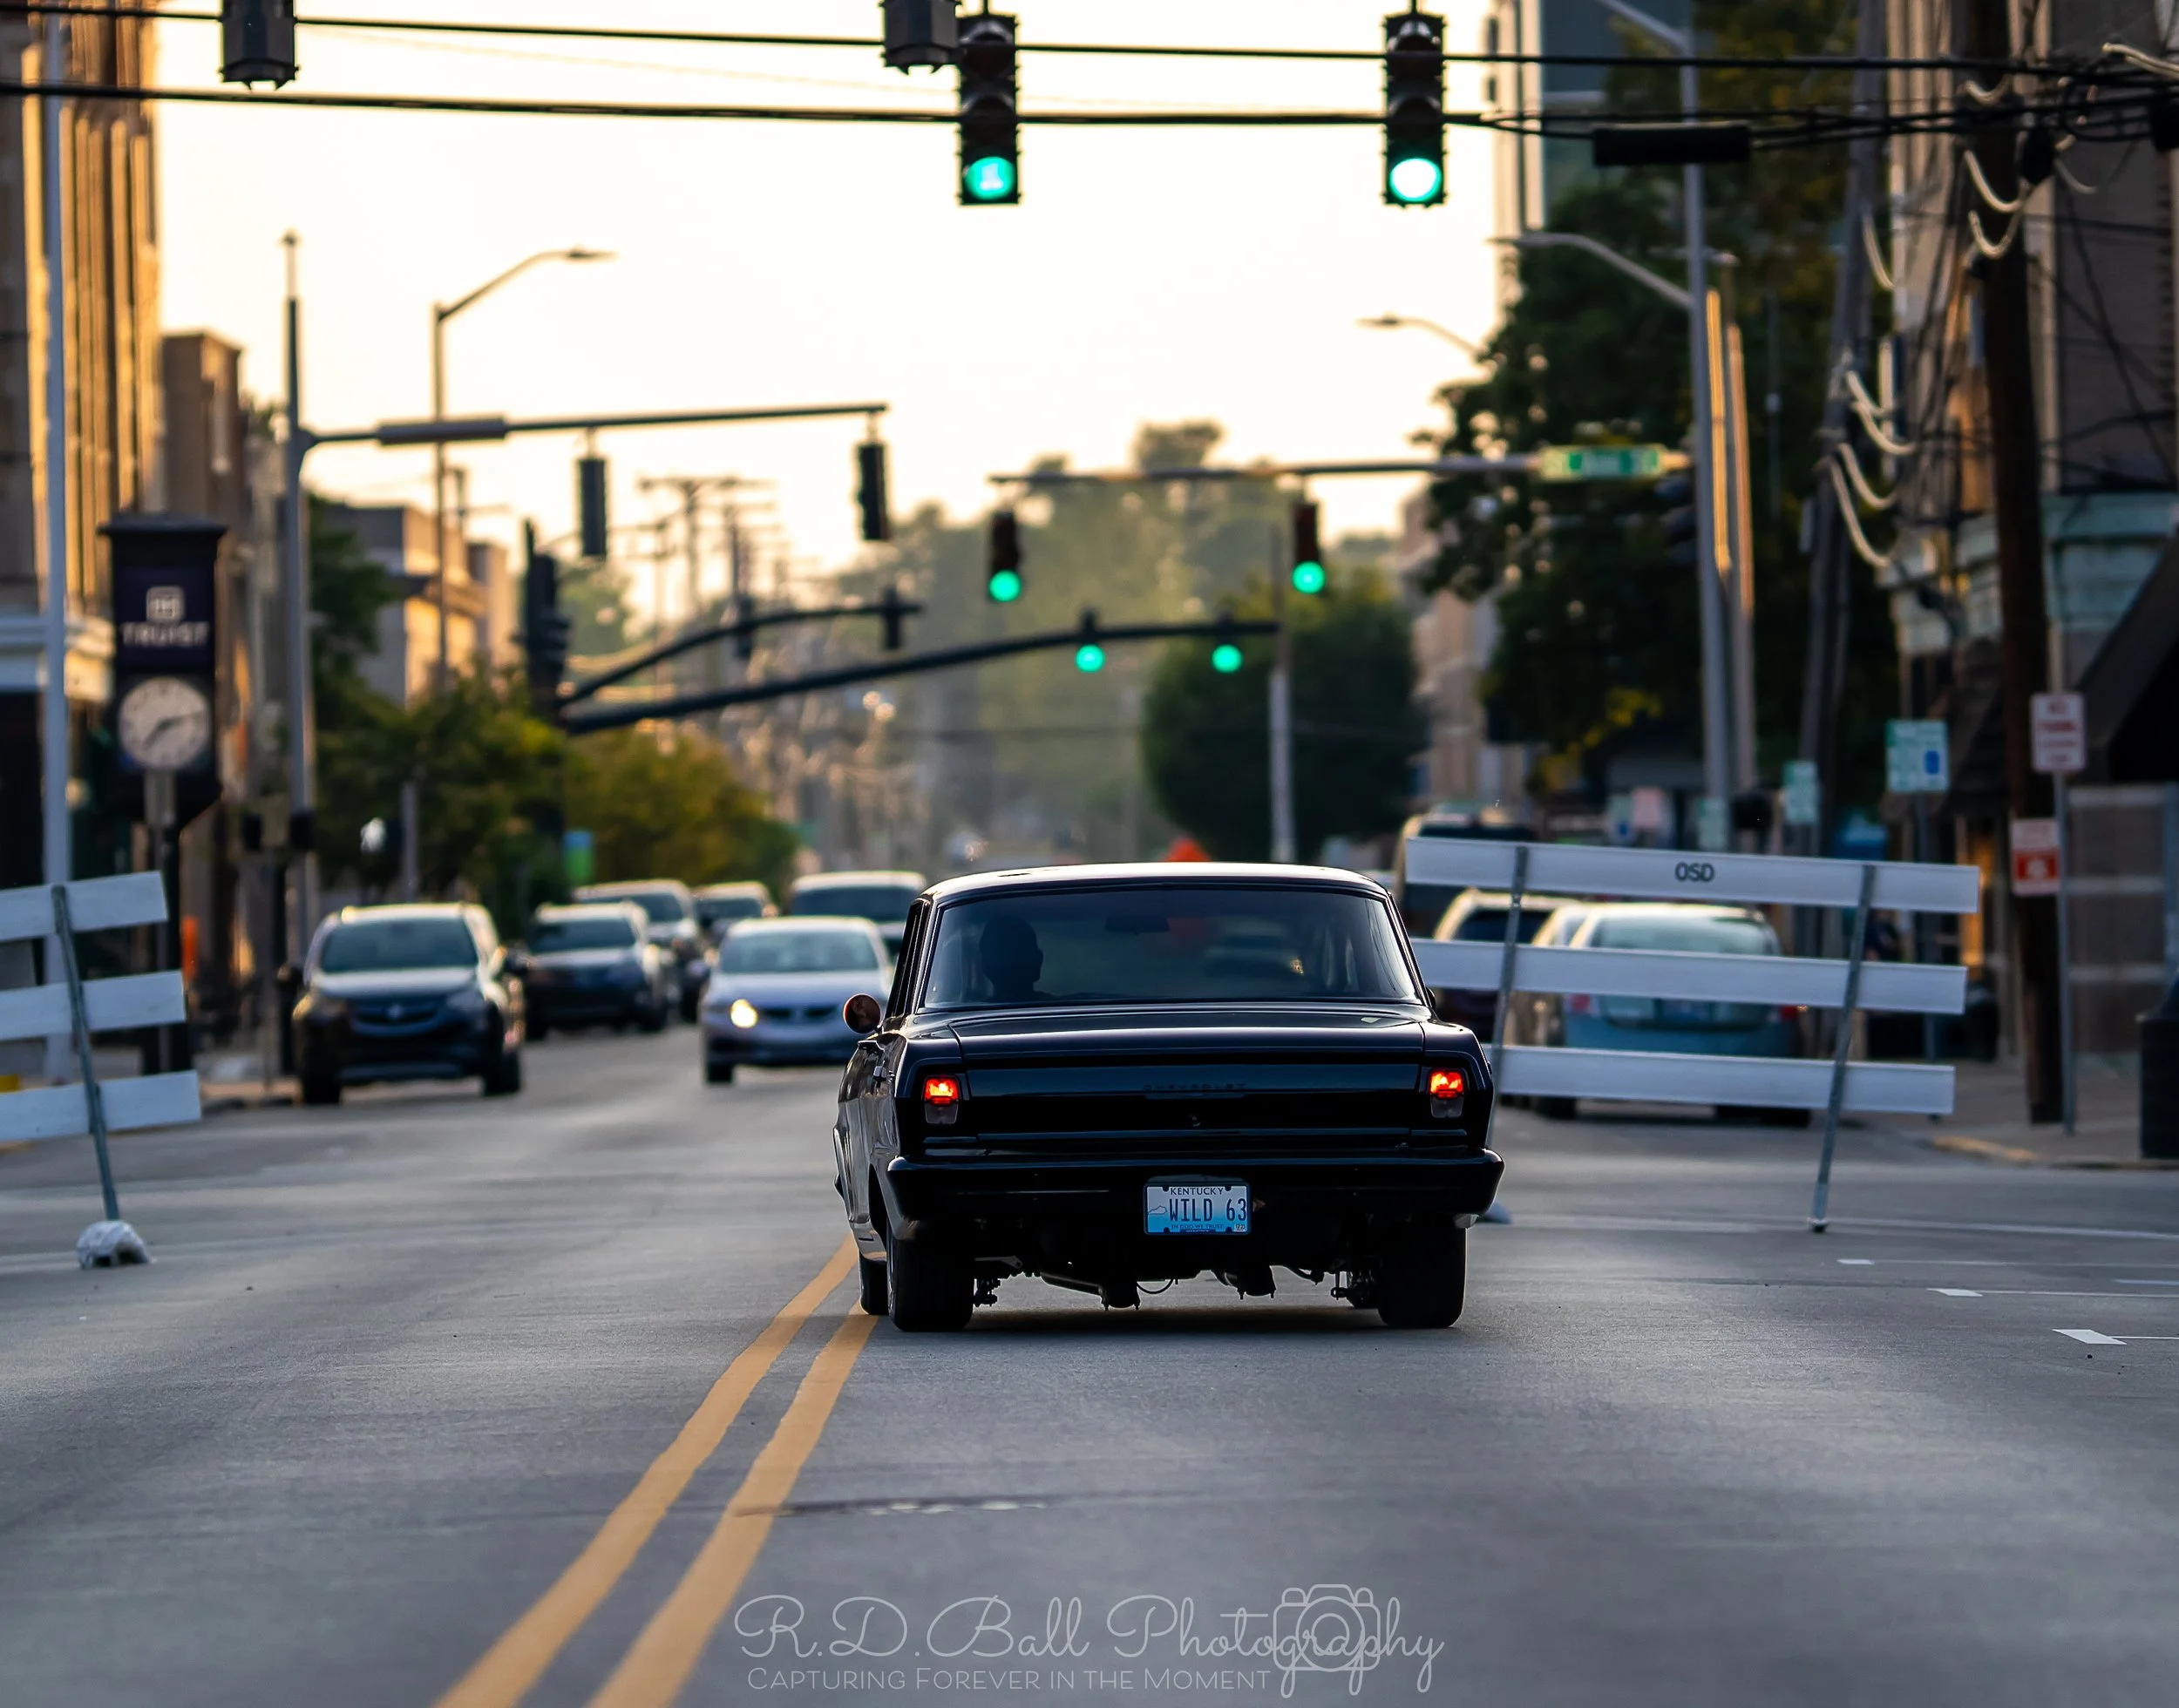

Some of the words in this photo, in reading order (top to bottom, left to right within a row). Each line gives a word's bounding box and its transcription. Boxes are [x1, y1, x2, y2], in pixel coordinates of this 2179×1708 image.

[121, 621, 209, 646] TRUIST
[1674, 862, 1715, 883] OSD
[1171, 1187, 1224, 1196] KENTUCKY
[1169, 1198, 1213, 1222] WILD
[1225, 1198, 1246, 1222] 63
